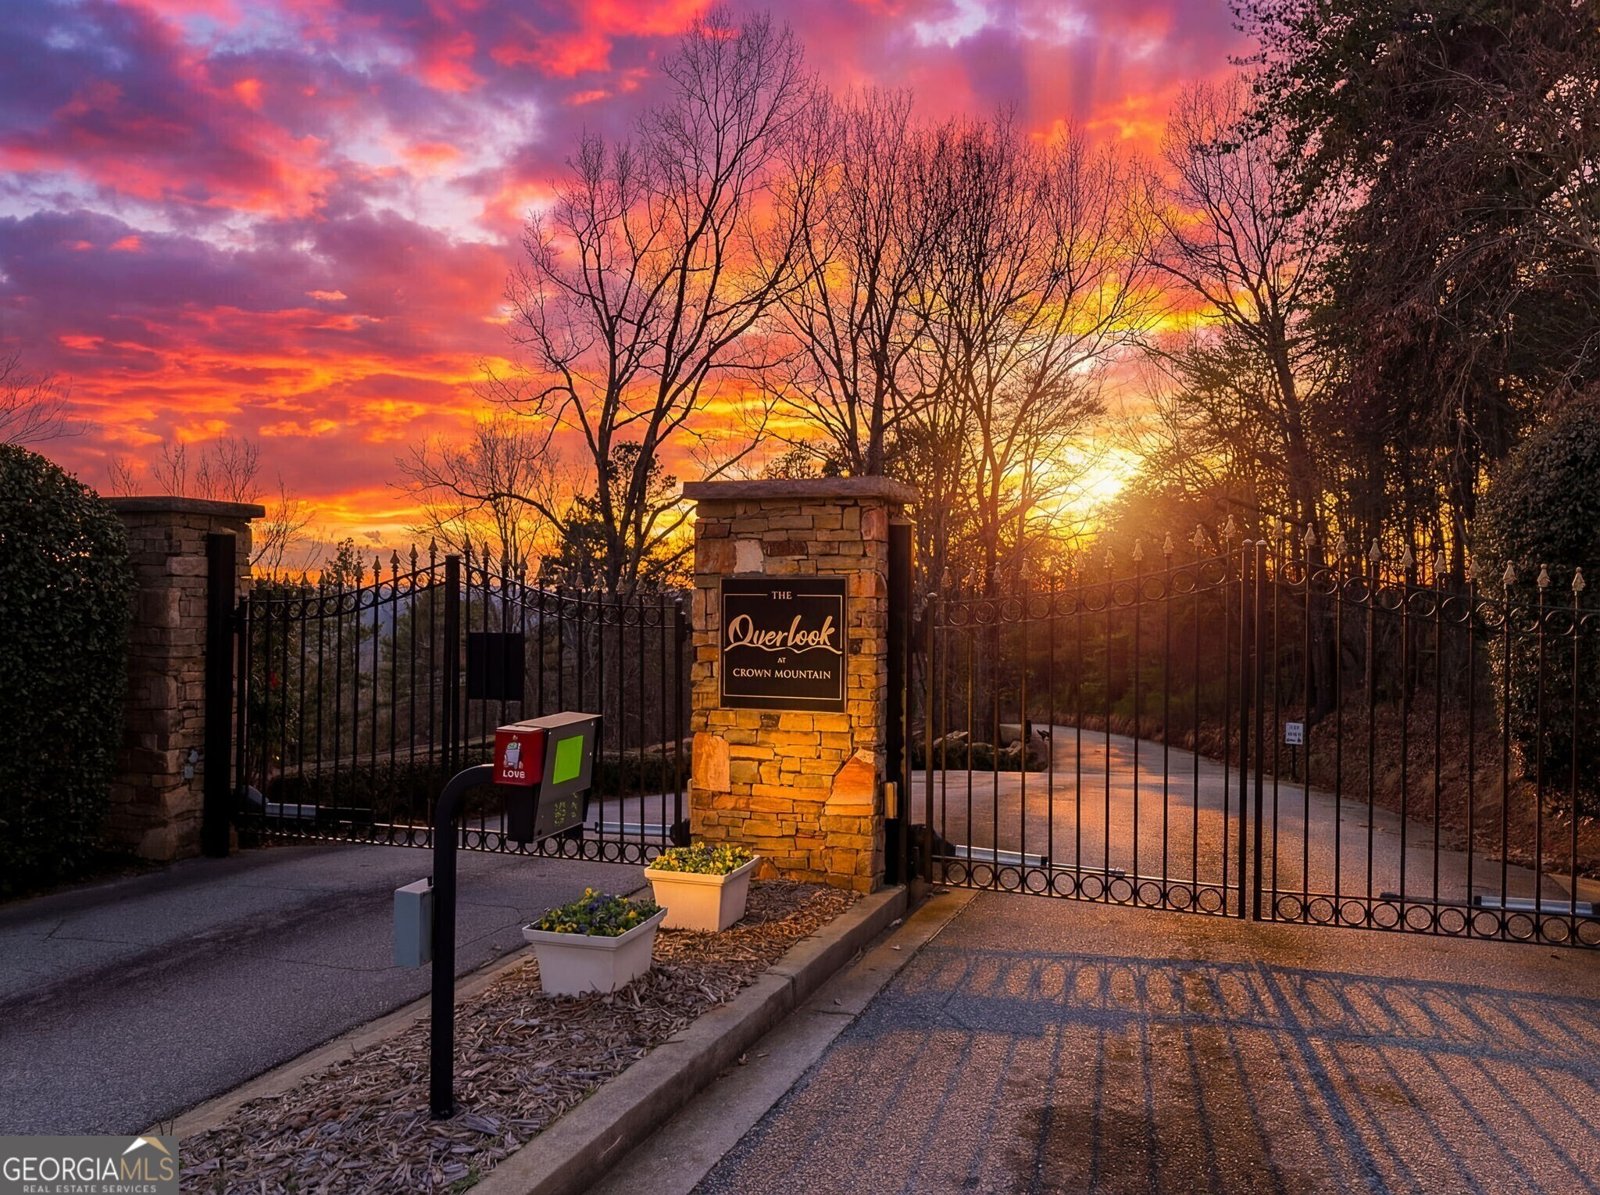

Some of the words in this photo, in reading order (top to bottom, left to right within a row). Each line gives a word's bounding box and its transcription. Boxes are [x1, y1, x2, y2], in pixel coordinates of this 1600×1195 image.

[771, 591, 792, 600] THE
[728, 614, 836, 647] Overlook
[732, 668, 772, 678] CROWN
[774, 669, 831, 679] MOUNTAIN
